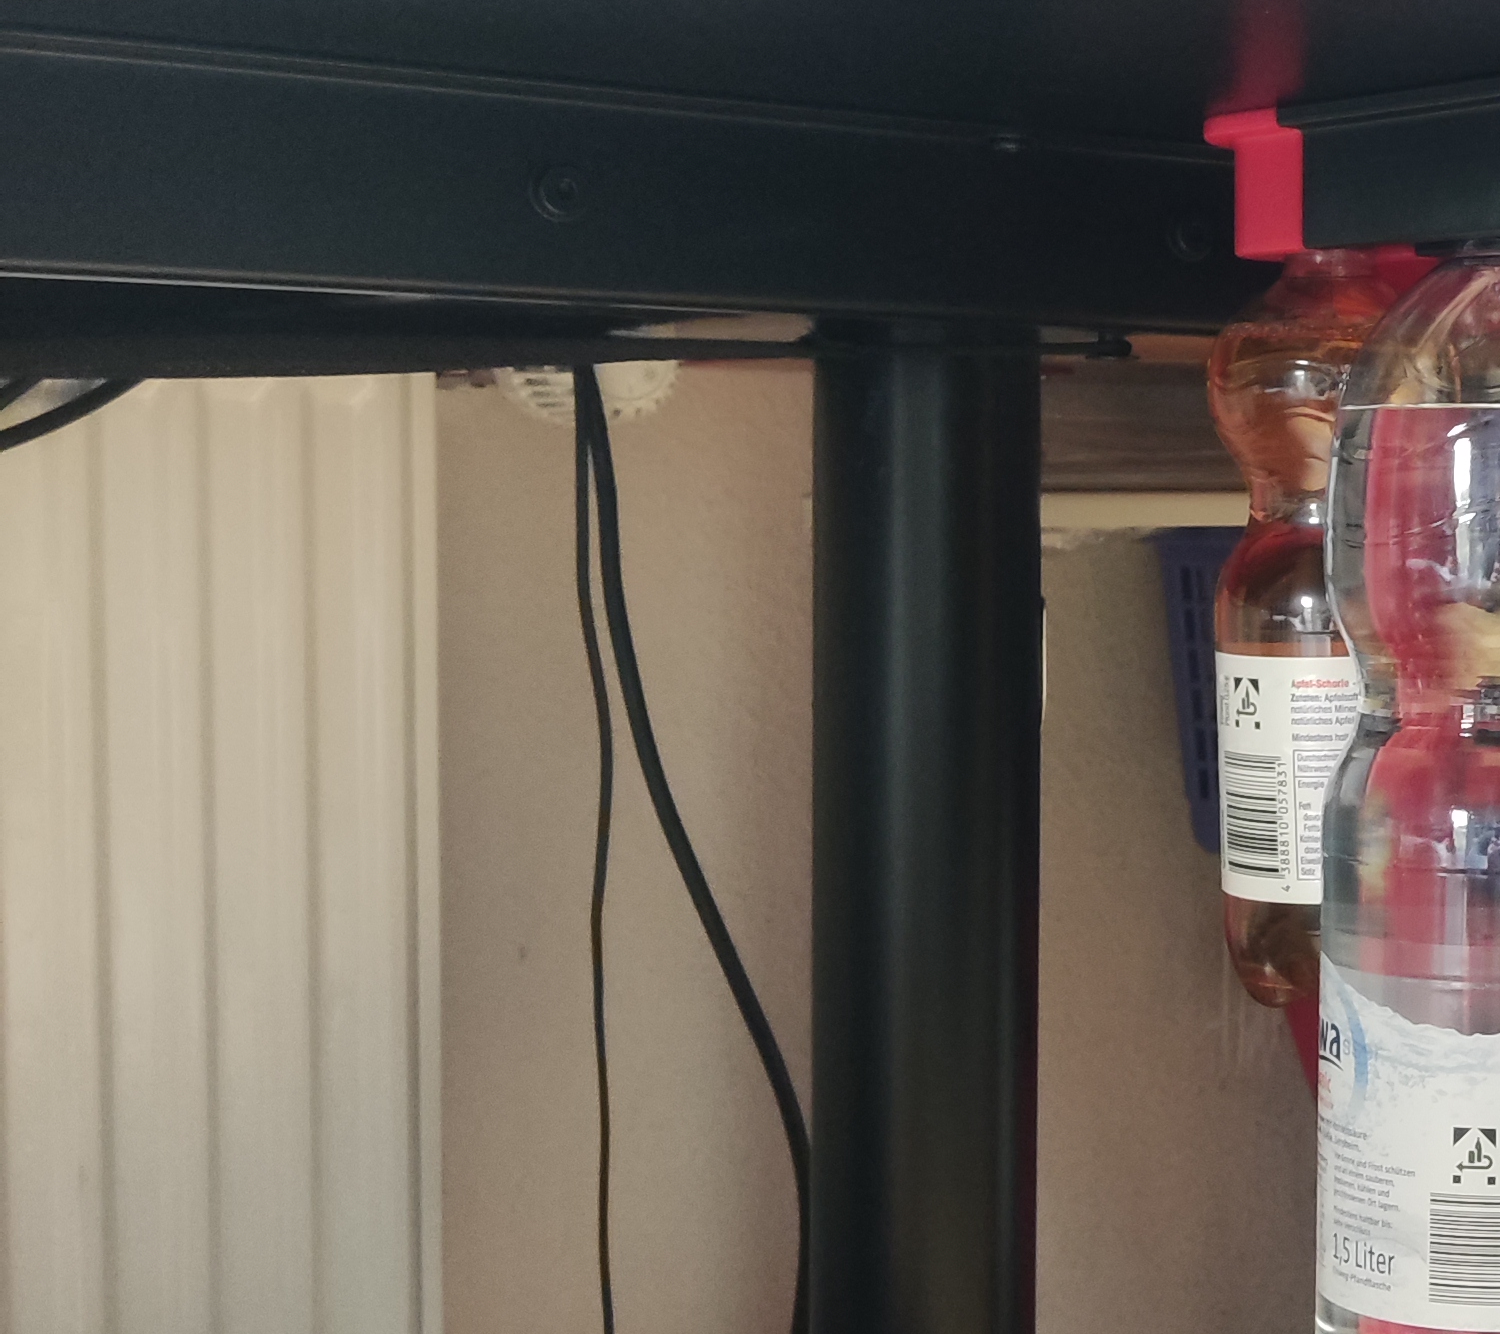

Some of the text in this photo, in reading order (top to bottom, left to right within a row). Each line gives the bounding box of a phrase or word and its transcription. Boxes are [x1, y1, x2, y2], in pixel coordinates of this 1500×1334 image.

[1291, 679, 1349, 690] Apfel-Schorle
[1277, 763, 1288, 814] 057831
[1280, 822, 1291, 874] 388810
[1333, 1232, 1395, 1276] 1,5 Liter
